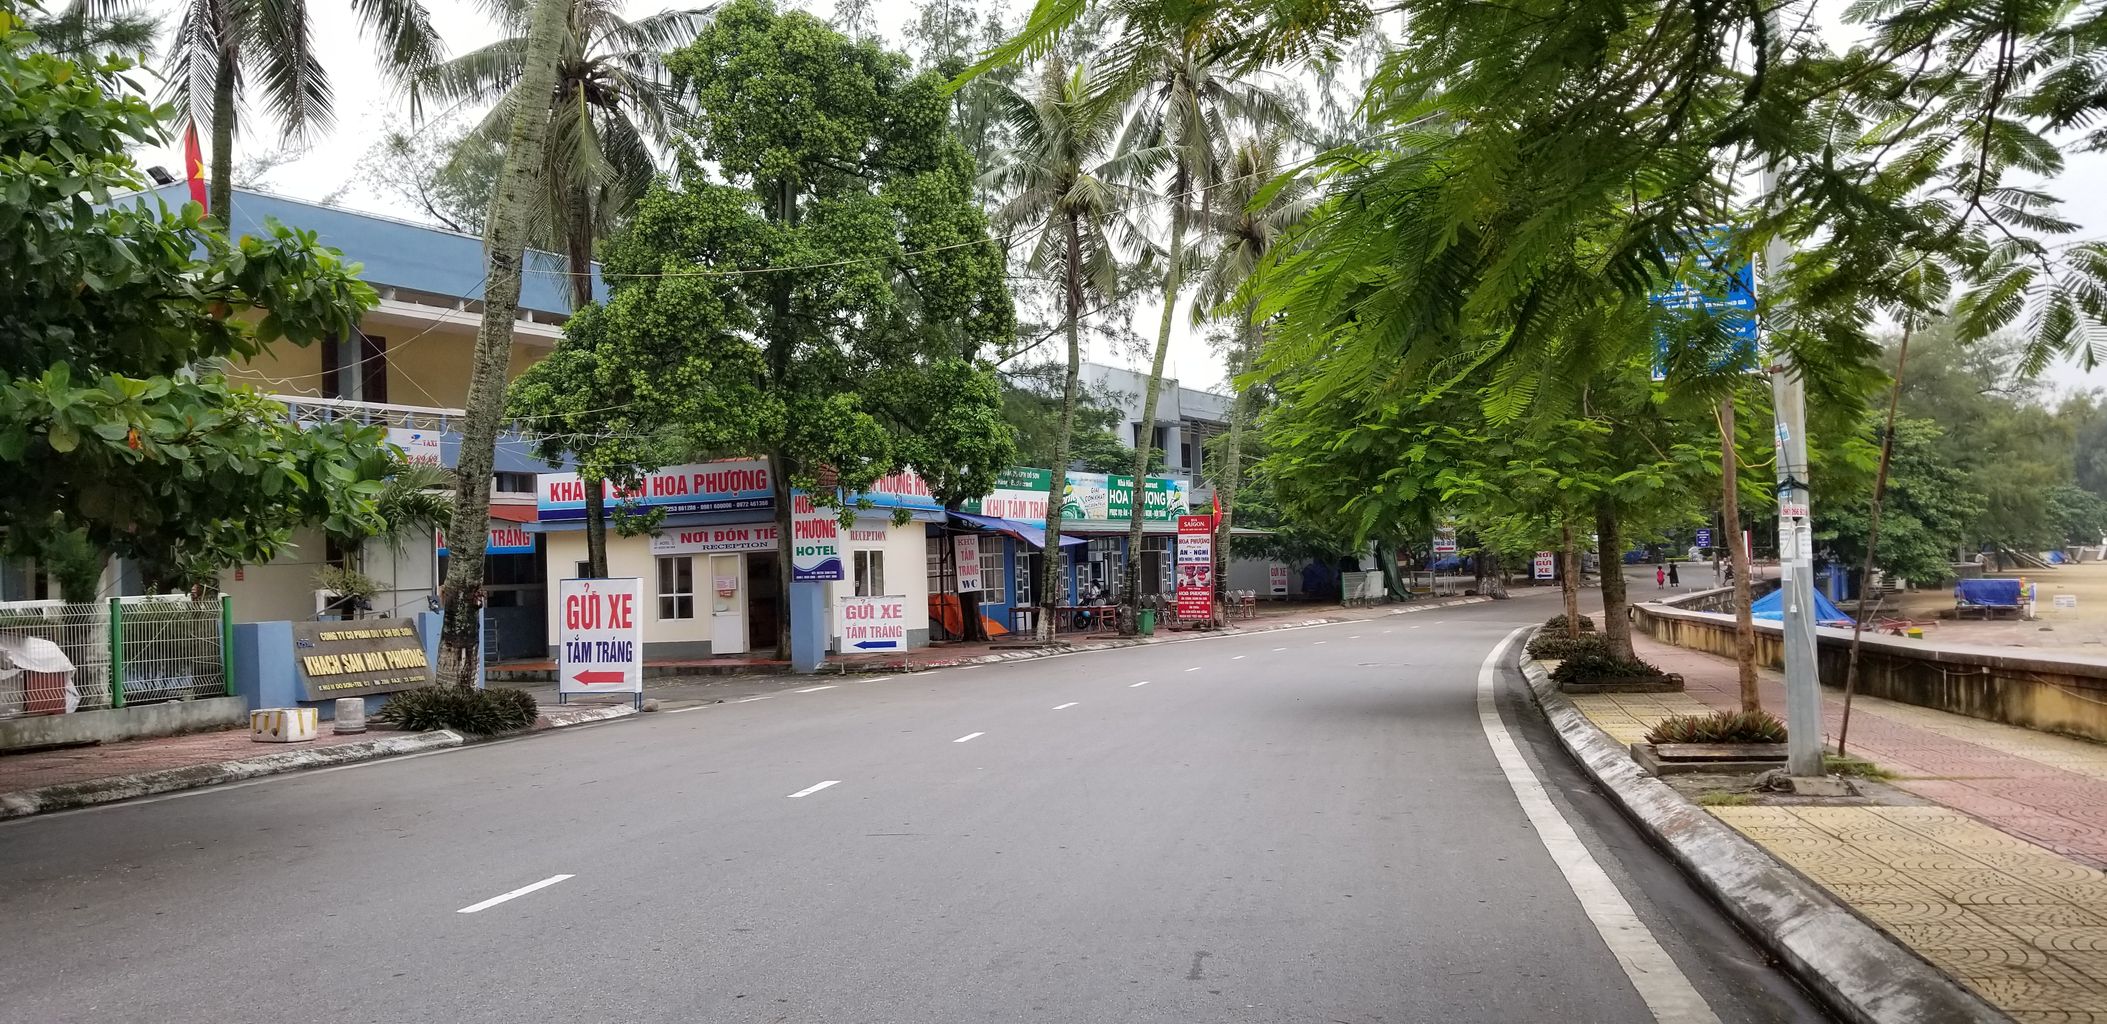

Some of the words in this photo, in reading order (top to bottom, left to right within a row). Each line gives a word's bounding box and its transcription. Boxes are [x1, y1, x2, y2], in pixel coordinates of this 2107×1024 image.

[653, 475, 688, 497] HOA
[694, 468, 767, 497] PHƯỢNG
[794, 495, 815, 514] HOA
[1109, 489, 1129, 505] HOA
[986, 499, 1005, 518] KHU
[1007, 494, 1026, 519] TẮM
[491, 526, 530, 547] TRÁNG
[680, 530, 709, 544] NƠI
[714, 527, 748, 542] ĐÓN
[795, 517, 837, 543] PHƯỢNG
[850, 530, 887, 541] RECEPTION
[702, 541, 768, 550] RECEPTION
[958, 538, 975, 546] KHU
[796, 545, 837, 557] HOTEL
[958, 564, 979, 577] TRÁNG
[961, 579, 978, 588] WC
[607, 593, 632, 629] XE
[880, 604, 903, 619] XE
[869, 623, 903, 638] TRÁNG
[566, 634, 592, 663] TẮM
[596, 636, 633, 663] TRÁNG
[340, 653, 366, 673] SAN
[363, 652, 388, 671] HOA
